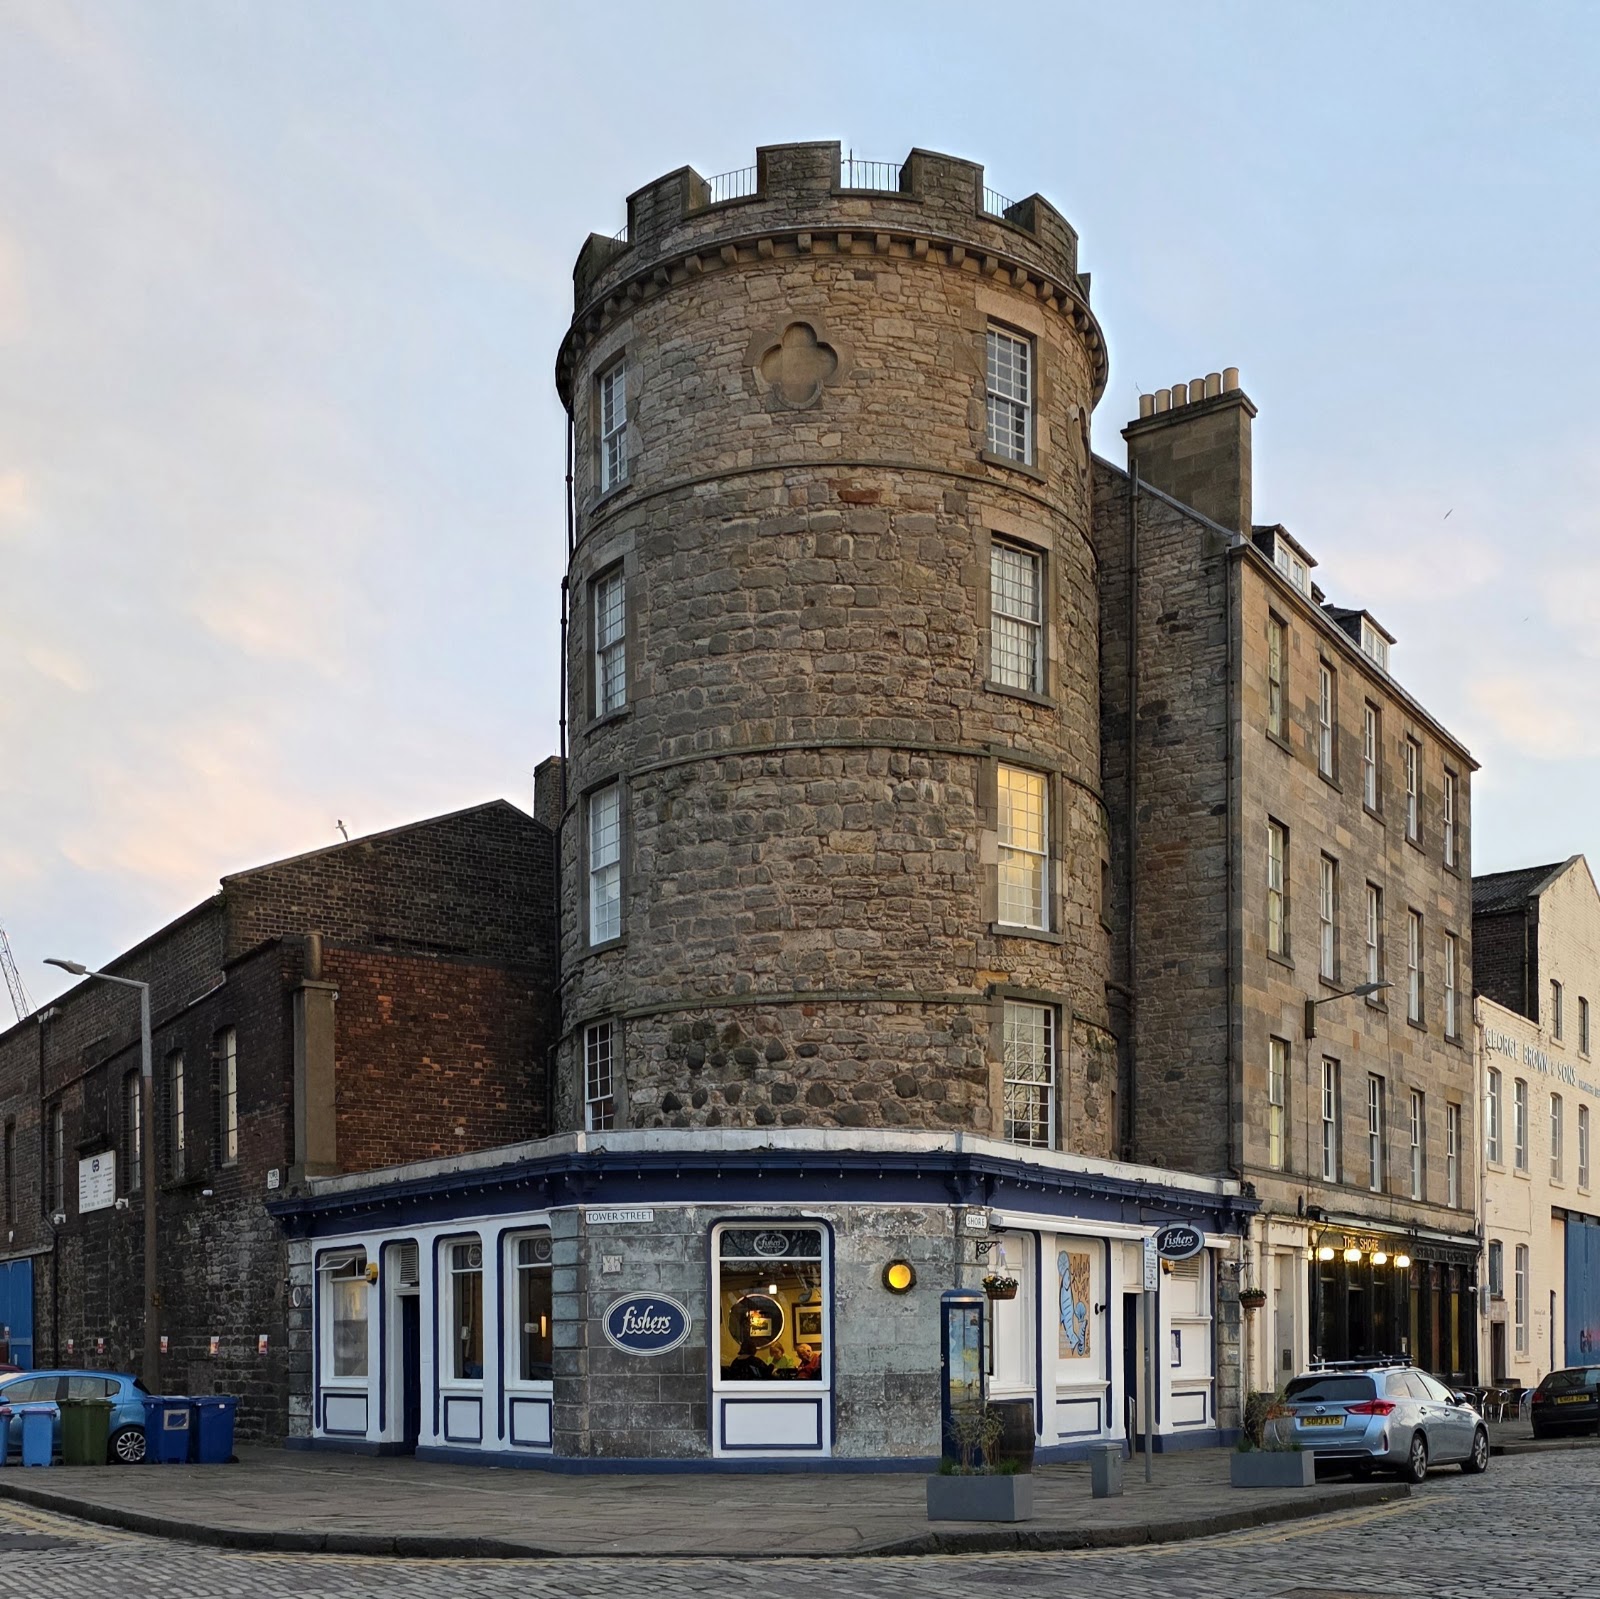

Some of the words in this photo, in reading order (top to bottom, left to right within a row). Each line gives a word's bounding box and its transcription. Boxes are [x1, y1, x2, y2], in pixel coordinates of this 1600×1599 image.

[1486, 1028, 1519, 1061] GEORGE
[1523, 1044, 1548, 1075] BROWN
[1557, 1061, 1576, 1087] SONS
[587, 1212, 619, 1222] TOWER
[620, 1211, 653, 1221] STREET
[967, 1216, 986, 1227] SHORE
[1160, 1230, 1195, 1252] fishers
[1343, 1235, 1357, 1249] THE
[1359, 1237, 1379, 1252] SHORE
[616, 1305, 672, 1339] fishers
[1325, 1415, 1340, 1425] AYS
